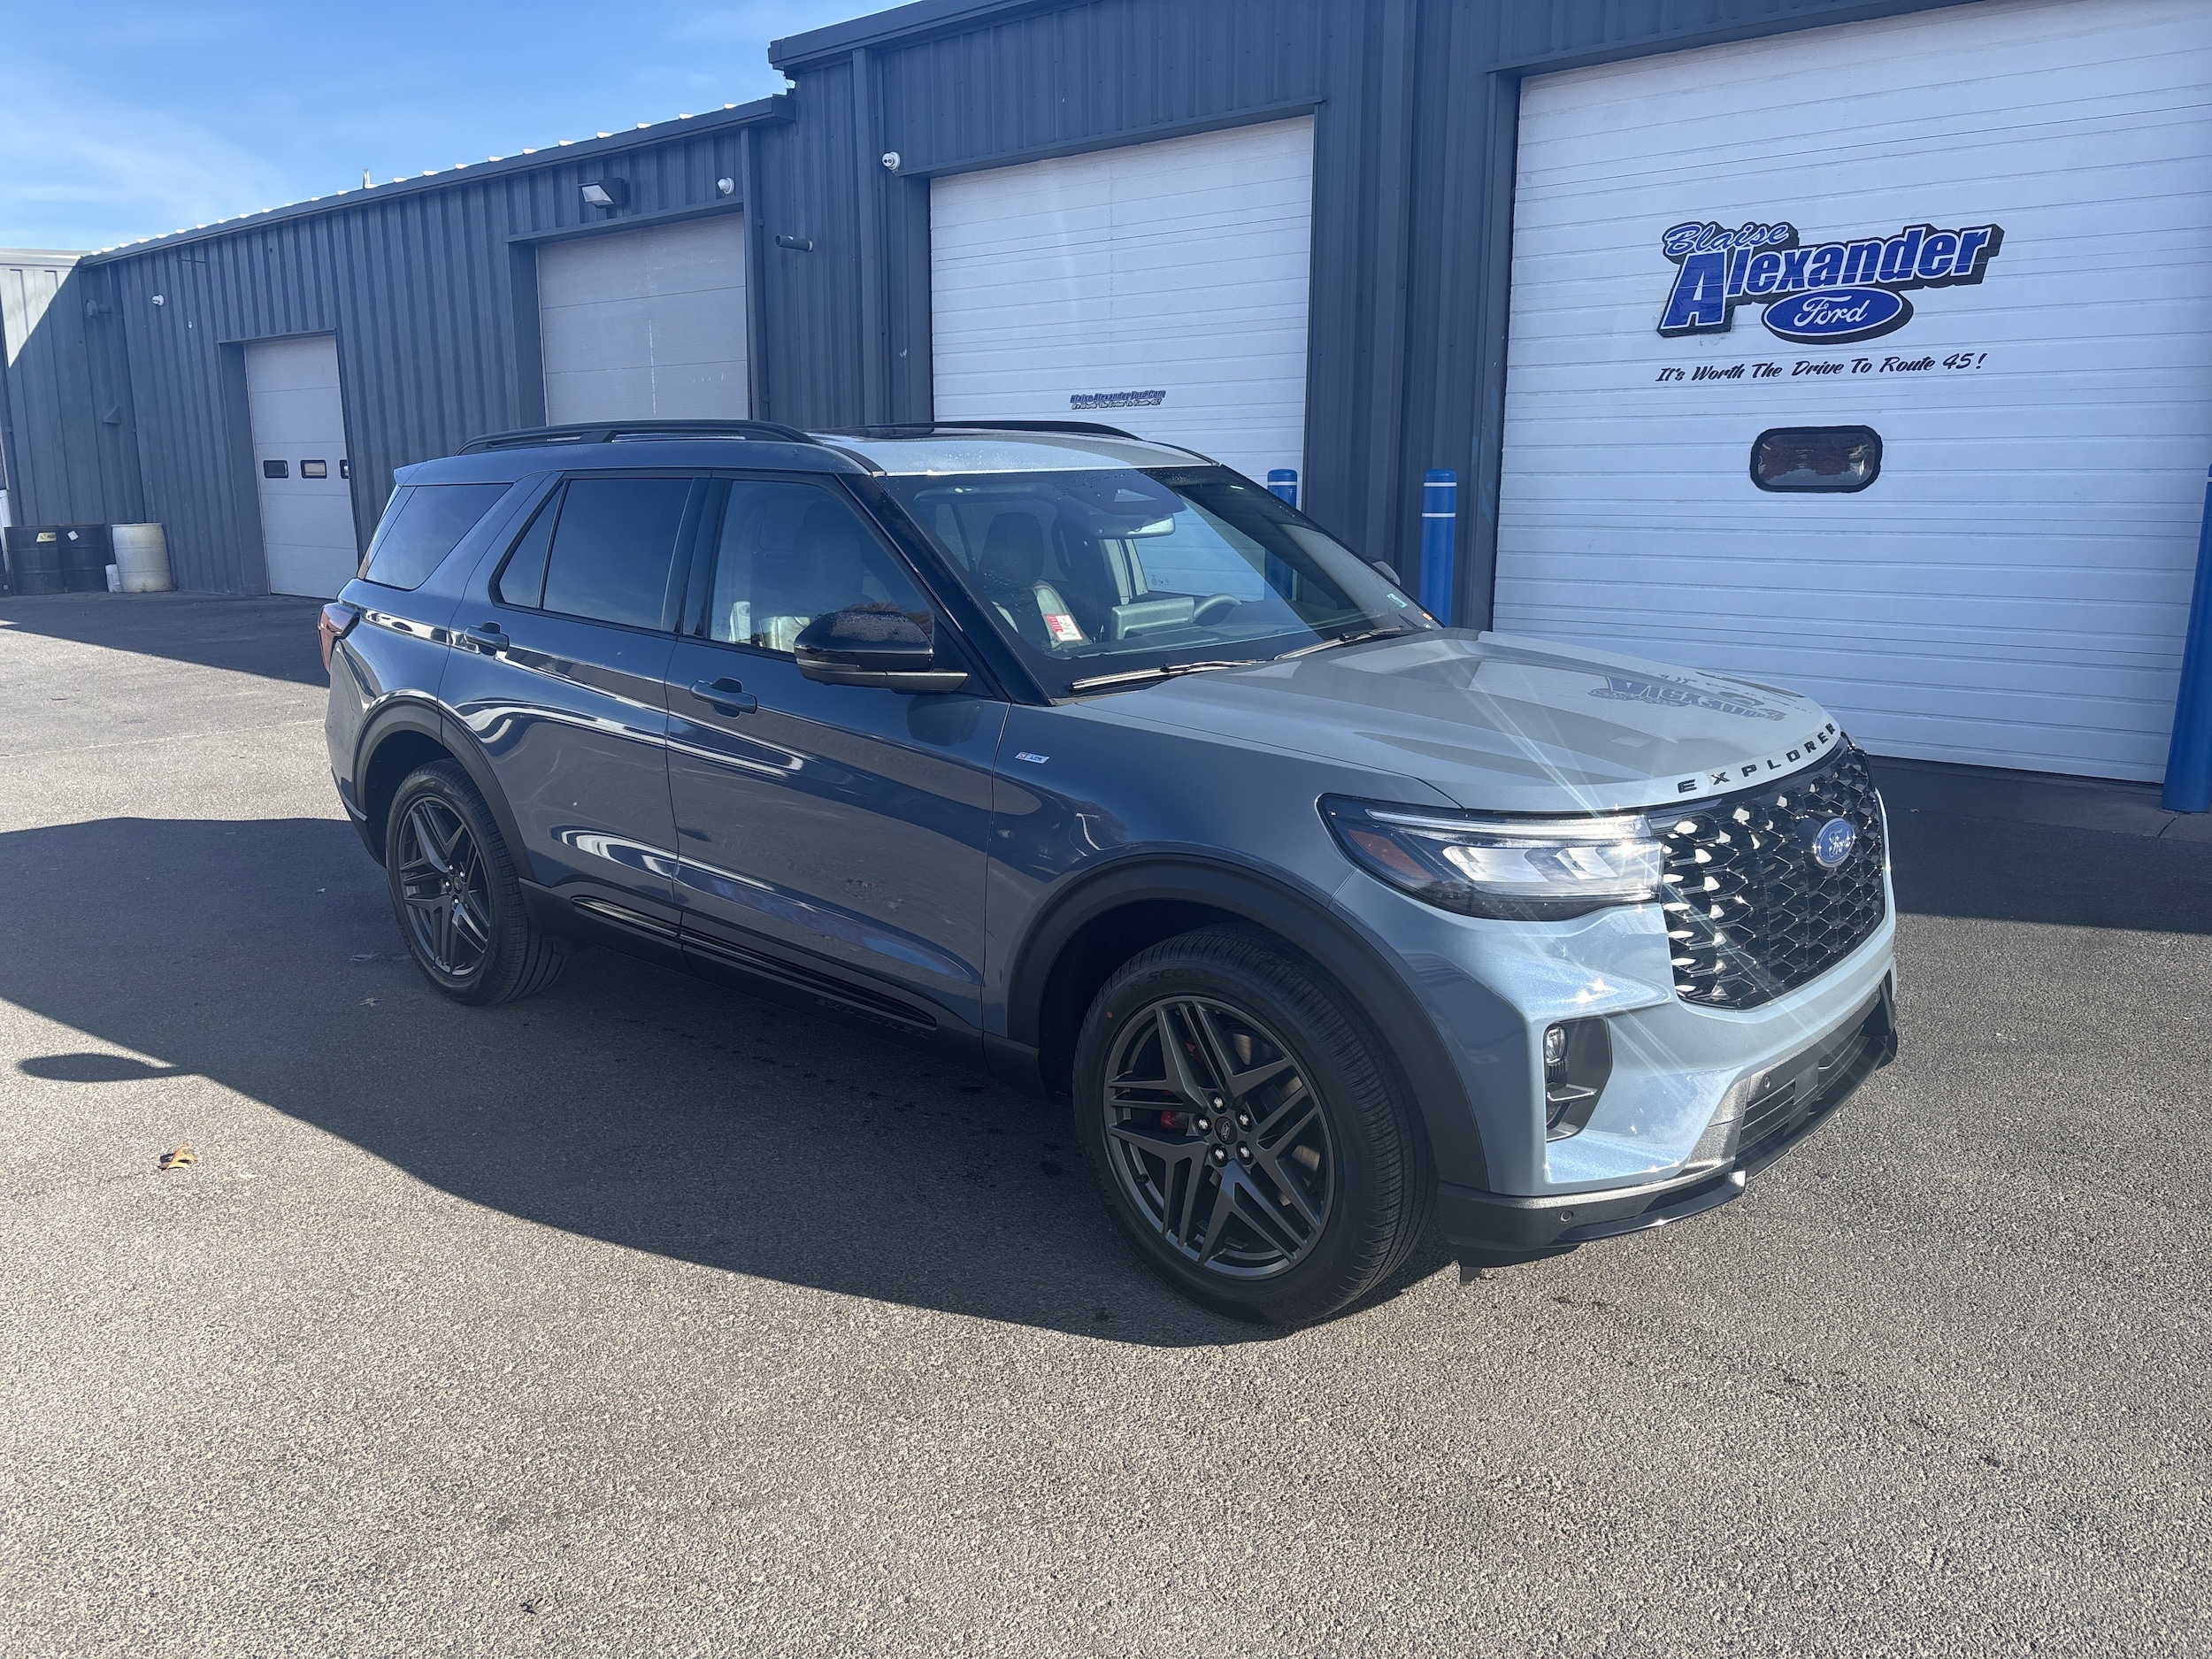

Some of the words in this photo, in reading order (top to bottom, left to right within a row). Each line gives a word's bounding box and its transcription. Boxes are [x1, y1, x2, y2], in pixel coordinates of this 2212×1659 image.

[1663, 222, 1791, 257] Blaise
[1659, 223, 1996, 331] Alexander
[1793, 295, 1871, 327] Ford
[1655, 367, 1686, 382] It's
[1691, 363, 1746, 381] Worth
[1751, 361, 1783, 379] The
[1791, 360, 1845, 376] Drive
[1851, 357, 1873, 374] To
[1878, 356, 1936, 373] Route
[1678, 722, 1835, 794] EXPLORER
